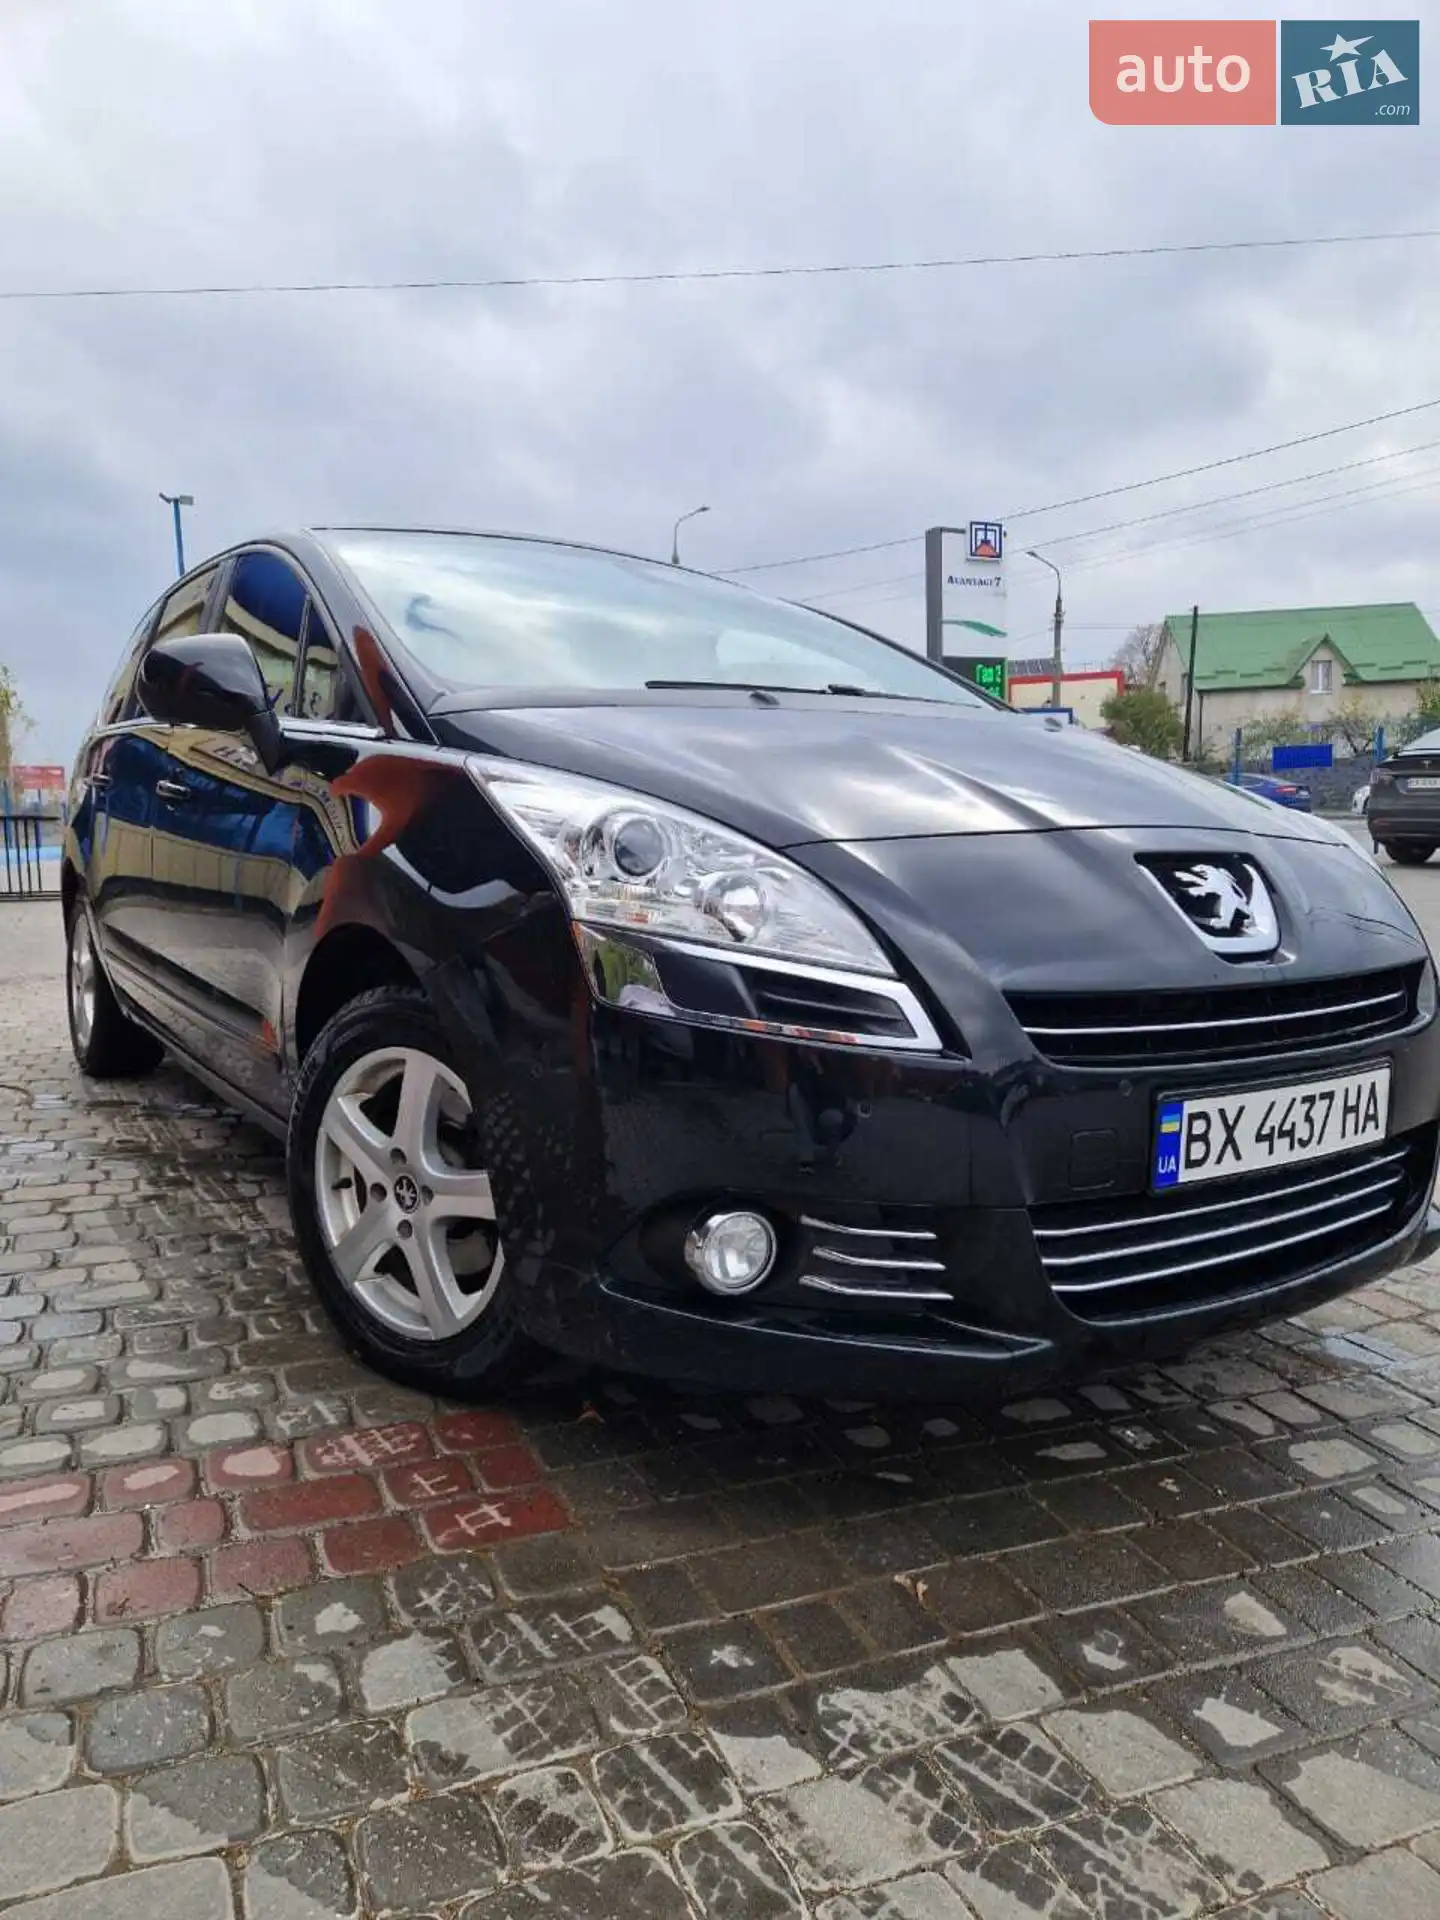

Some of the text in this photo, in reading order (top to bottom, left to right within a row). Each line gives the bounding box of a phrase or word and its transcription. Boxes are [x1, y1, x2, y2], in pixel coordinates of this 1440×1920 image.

[1184, 1080, 1380, 1170] BX 4437 HA
[1157, 1156, 1177, 1174] UA
